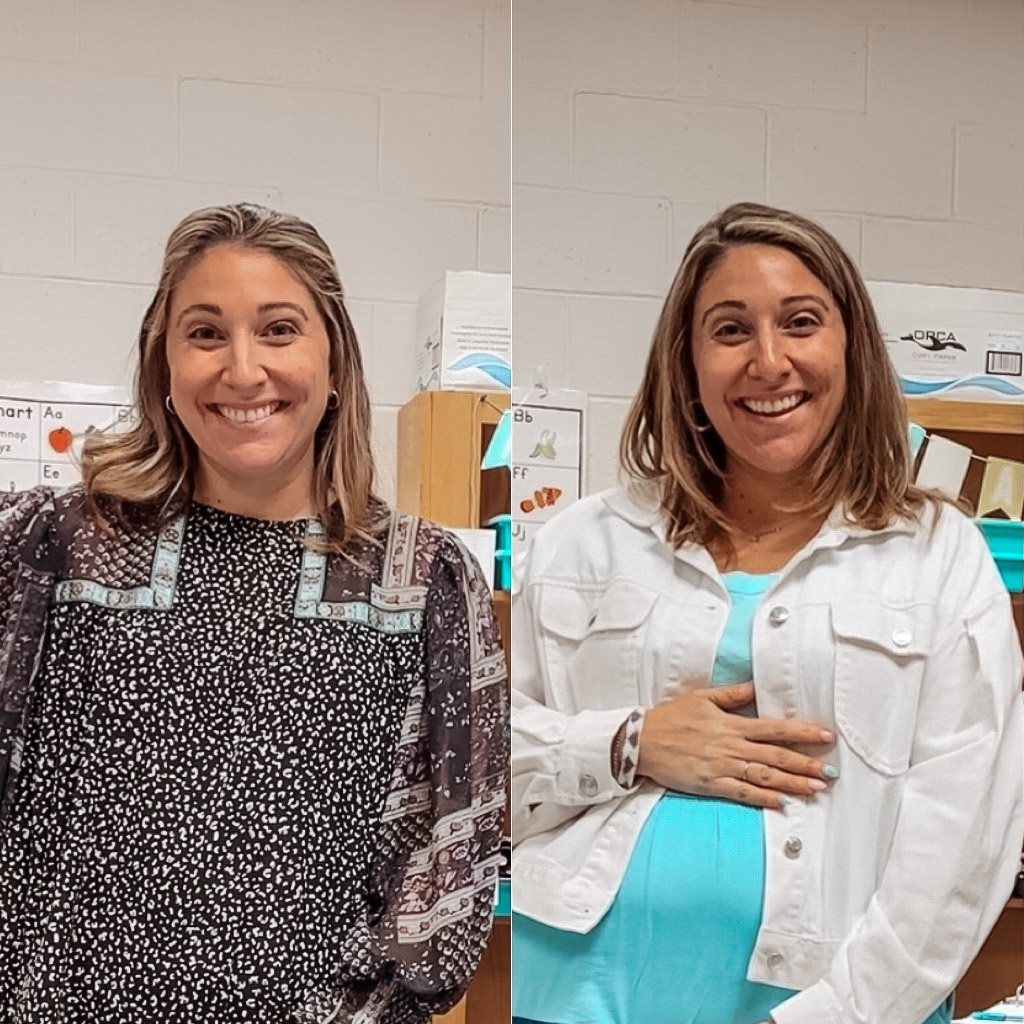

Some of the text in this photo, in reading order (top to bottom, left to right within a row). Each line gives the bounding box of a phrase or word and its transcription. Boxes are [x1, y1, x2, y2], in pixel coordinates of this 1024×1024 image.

[914, 330, 957, 342] ORCA
[44, 406, 63, 419] Aa
[513, 408, 534, 424] Bb
[43, 464, 60, 479] Ee
[512, 466, 529, 480] Ff
